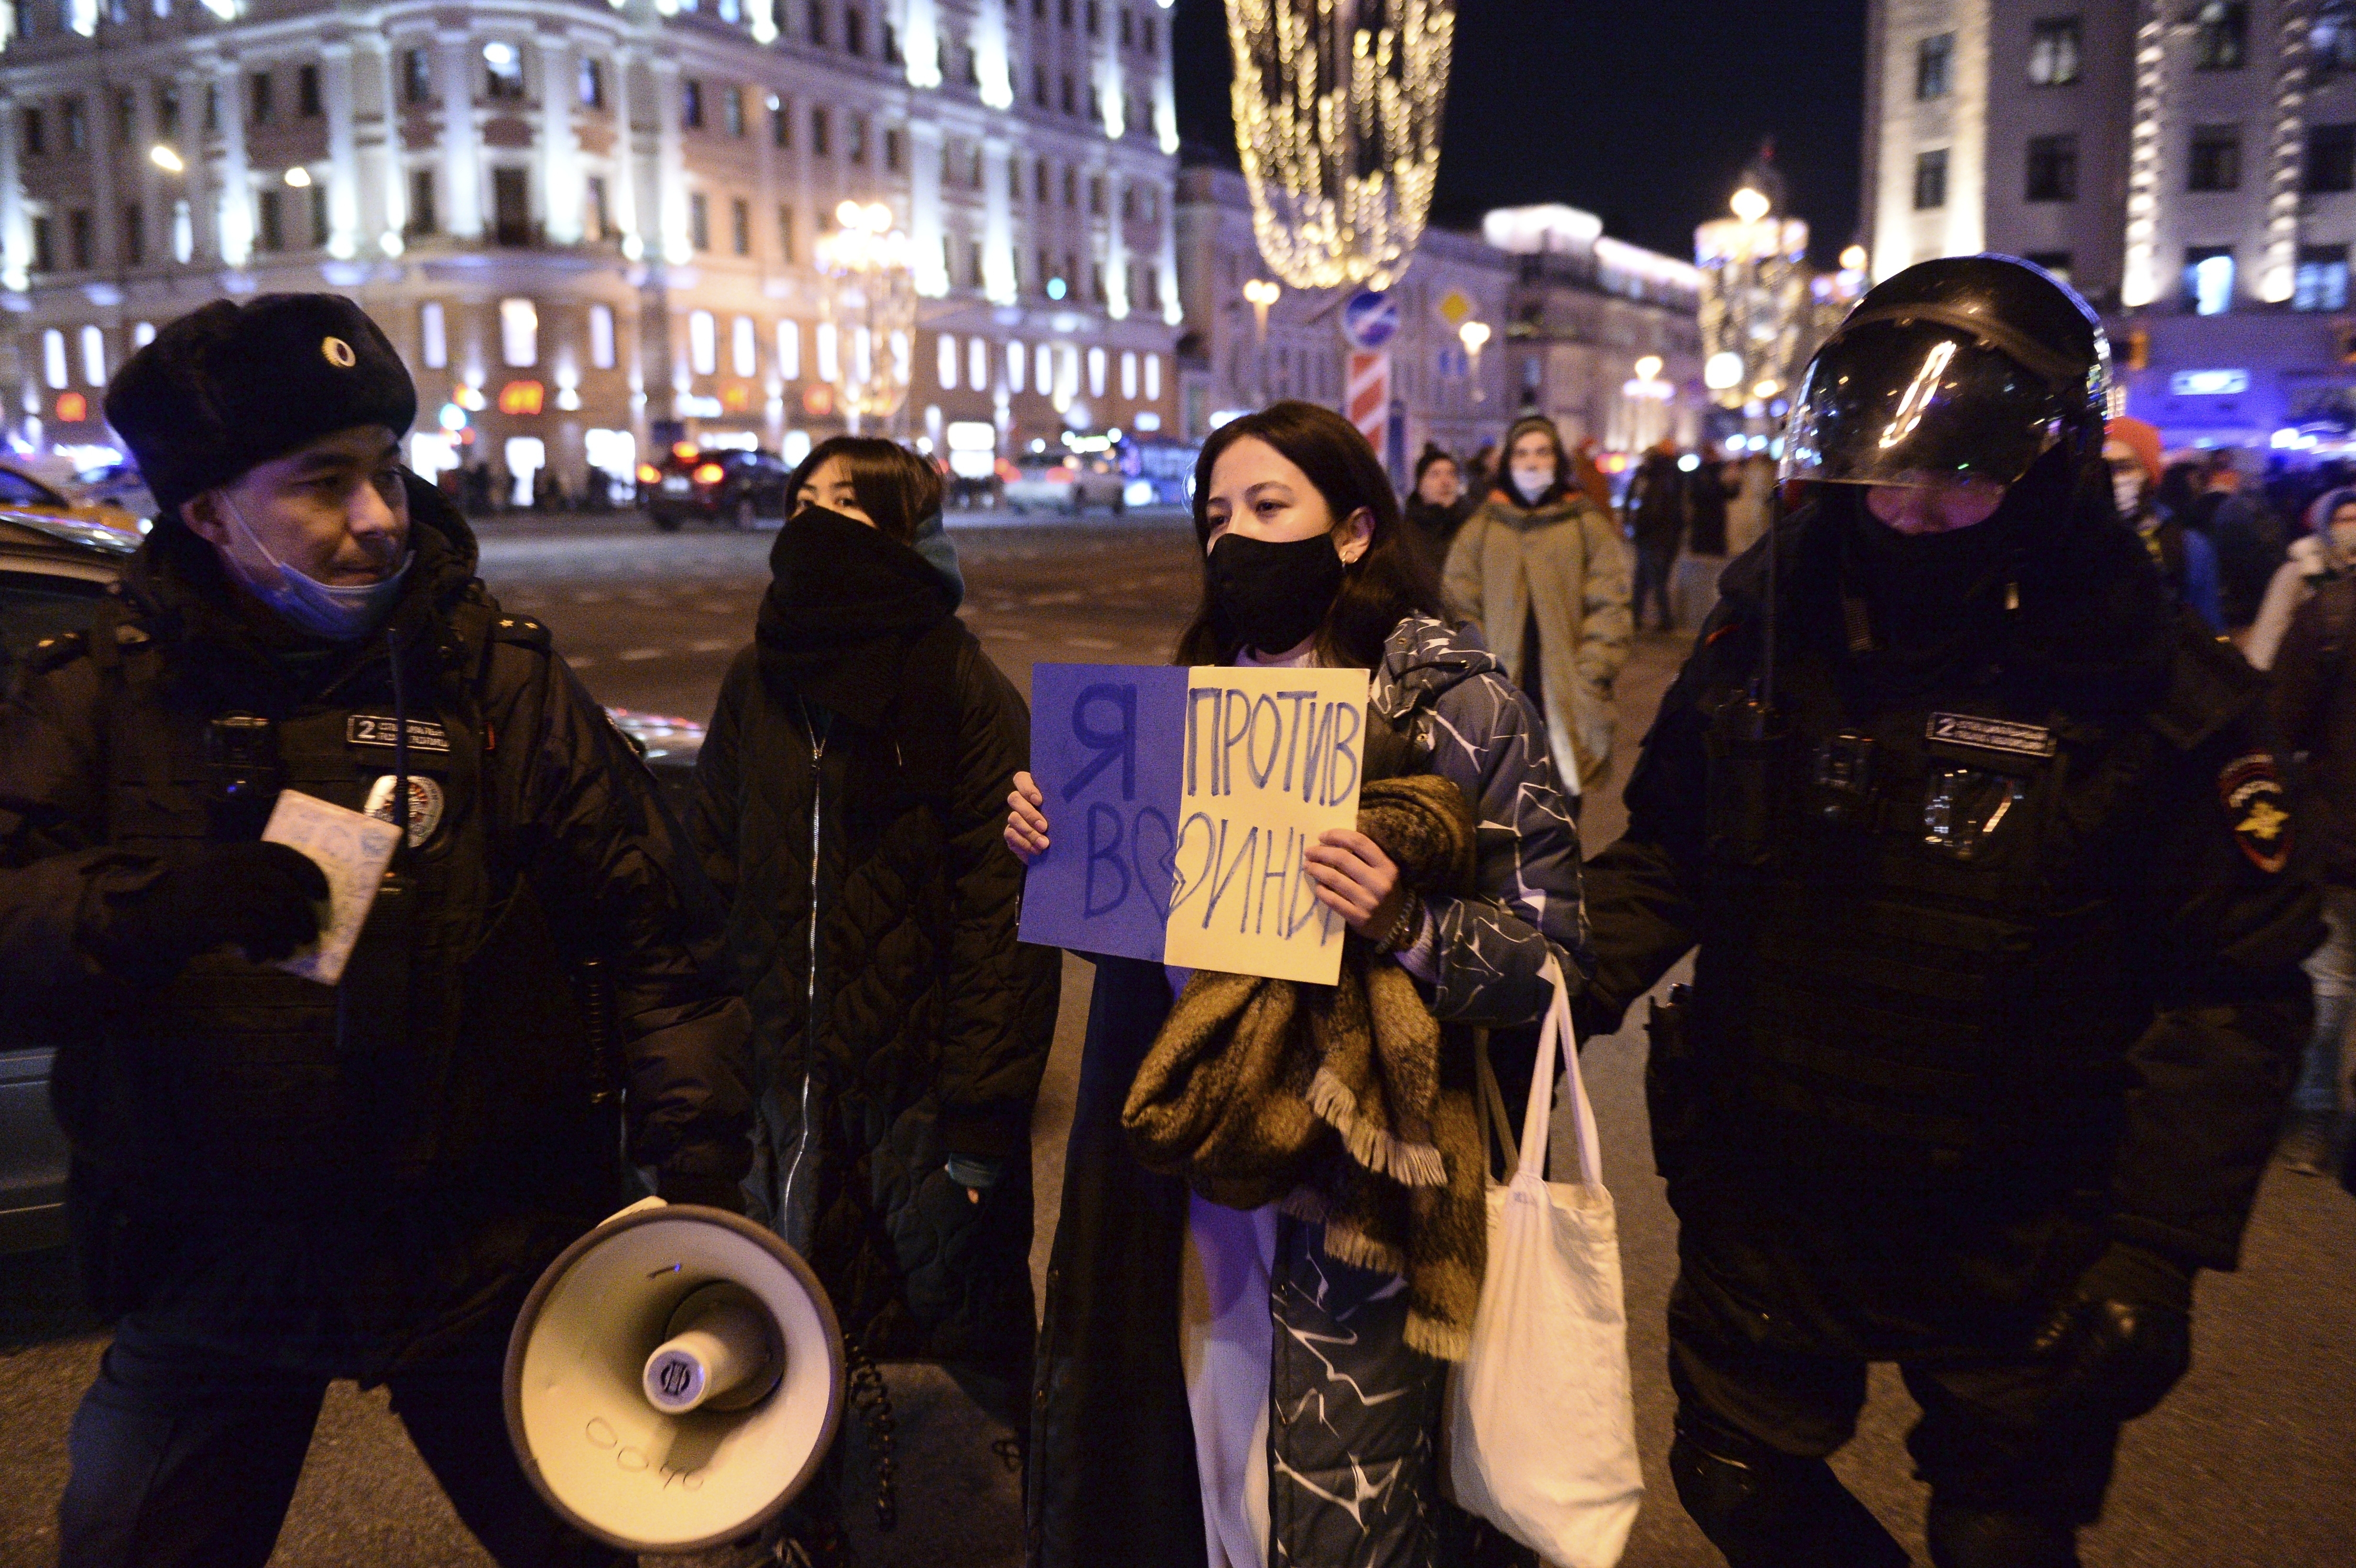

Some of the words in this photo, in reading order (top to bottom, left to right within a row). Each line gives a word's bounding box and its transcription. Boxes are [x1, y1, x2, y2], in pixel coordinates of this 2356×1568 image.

[358, 720, 376, 739] 2
[1937, 718, 1956, 736] 2
[1061, 683, 1137, 802] Я
[1187, 687, 1361, 807] ПРОТИВ
